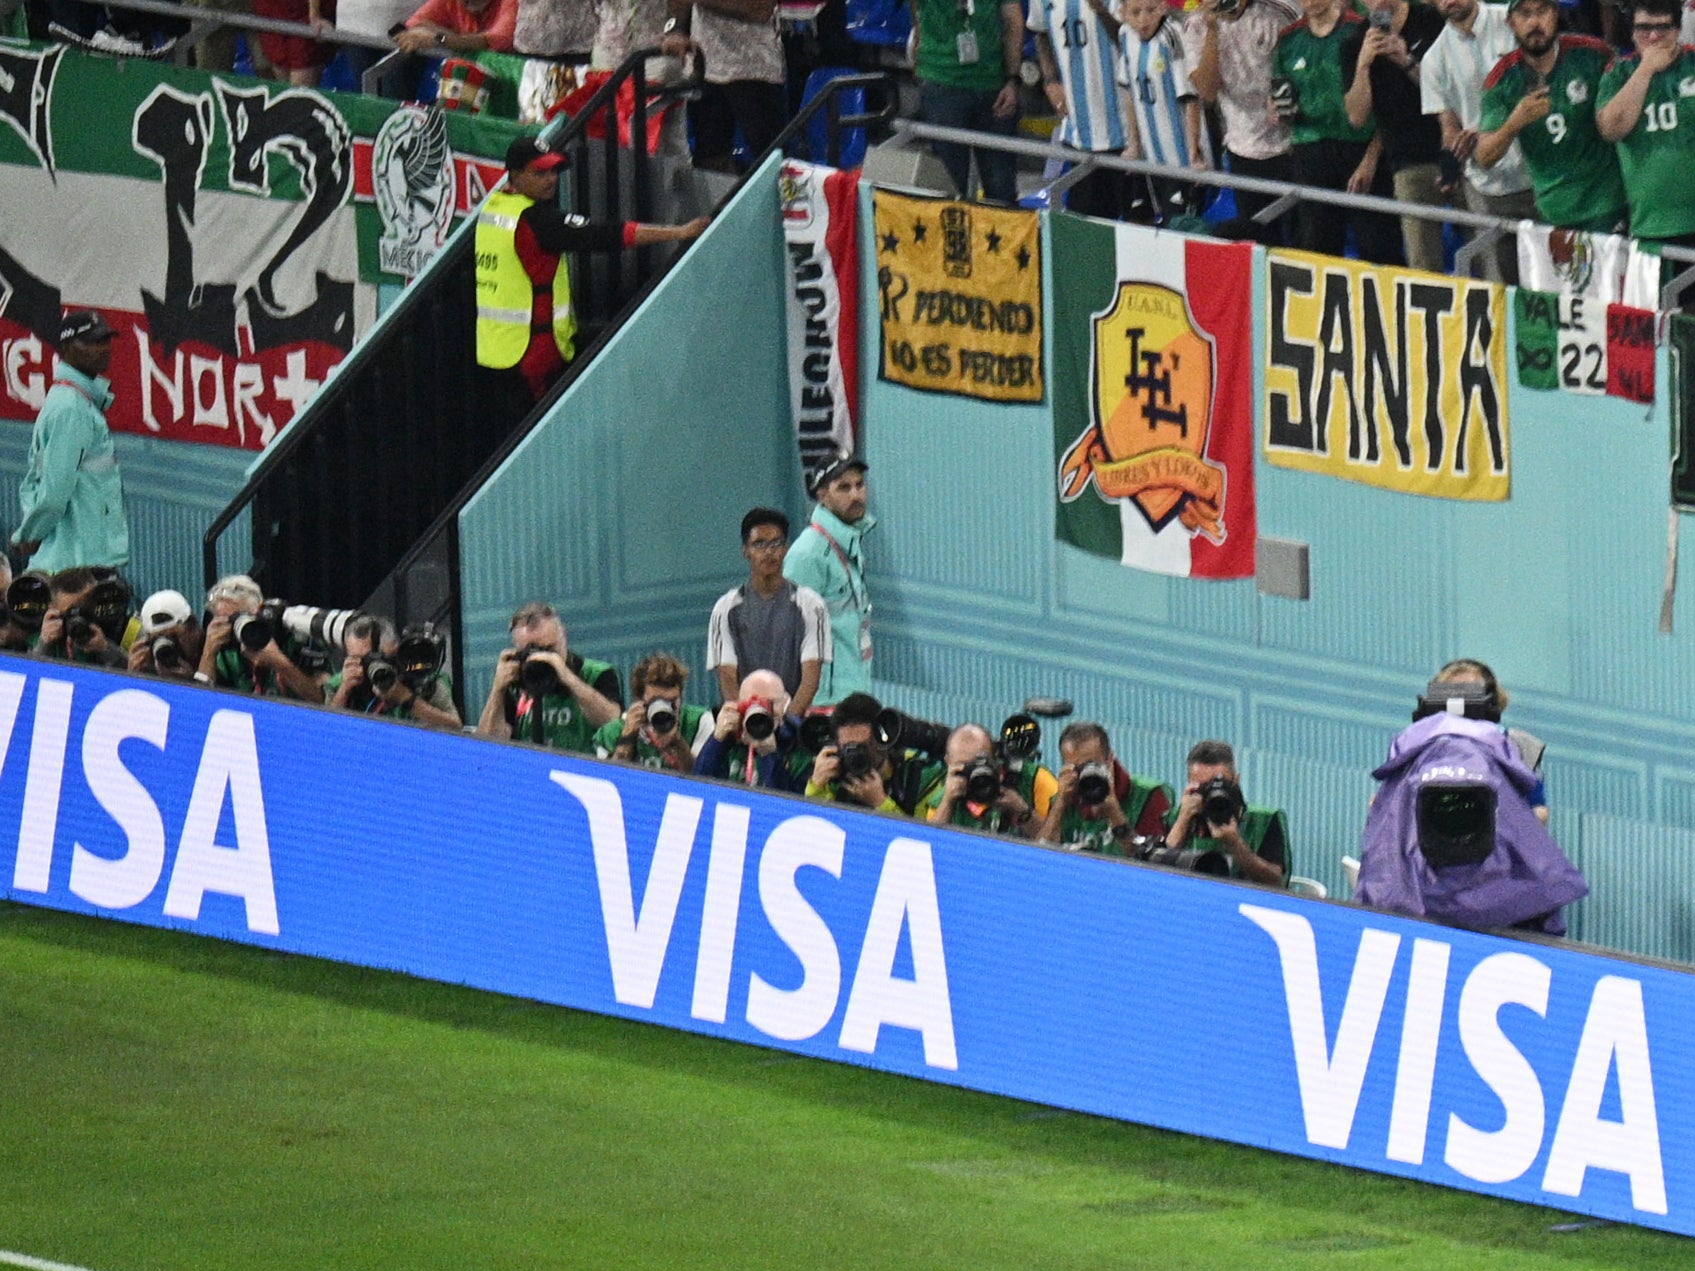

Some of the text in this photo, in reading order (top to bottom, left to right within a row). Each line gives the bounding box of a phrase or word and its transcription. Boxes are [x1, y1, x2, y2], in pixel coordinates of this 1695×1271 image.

[1545, 112, 1568, 144] 9
[1644, 101, 1679, 133] 10
[1267, 258, 1506, 476] SANTA
[1561, 342, 1607, 389] 22
[0, 670, 280, 937] ISA
[549, 769, 959, 1071] VISA
[1238, 903, 1669, 1217] VISA
